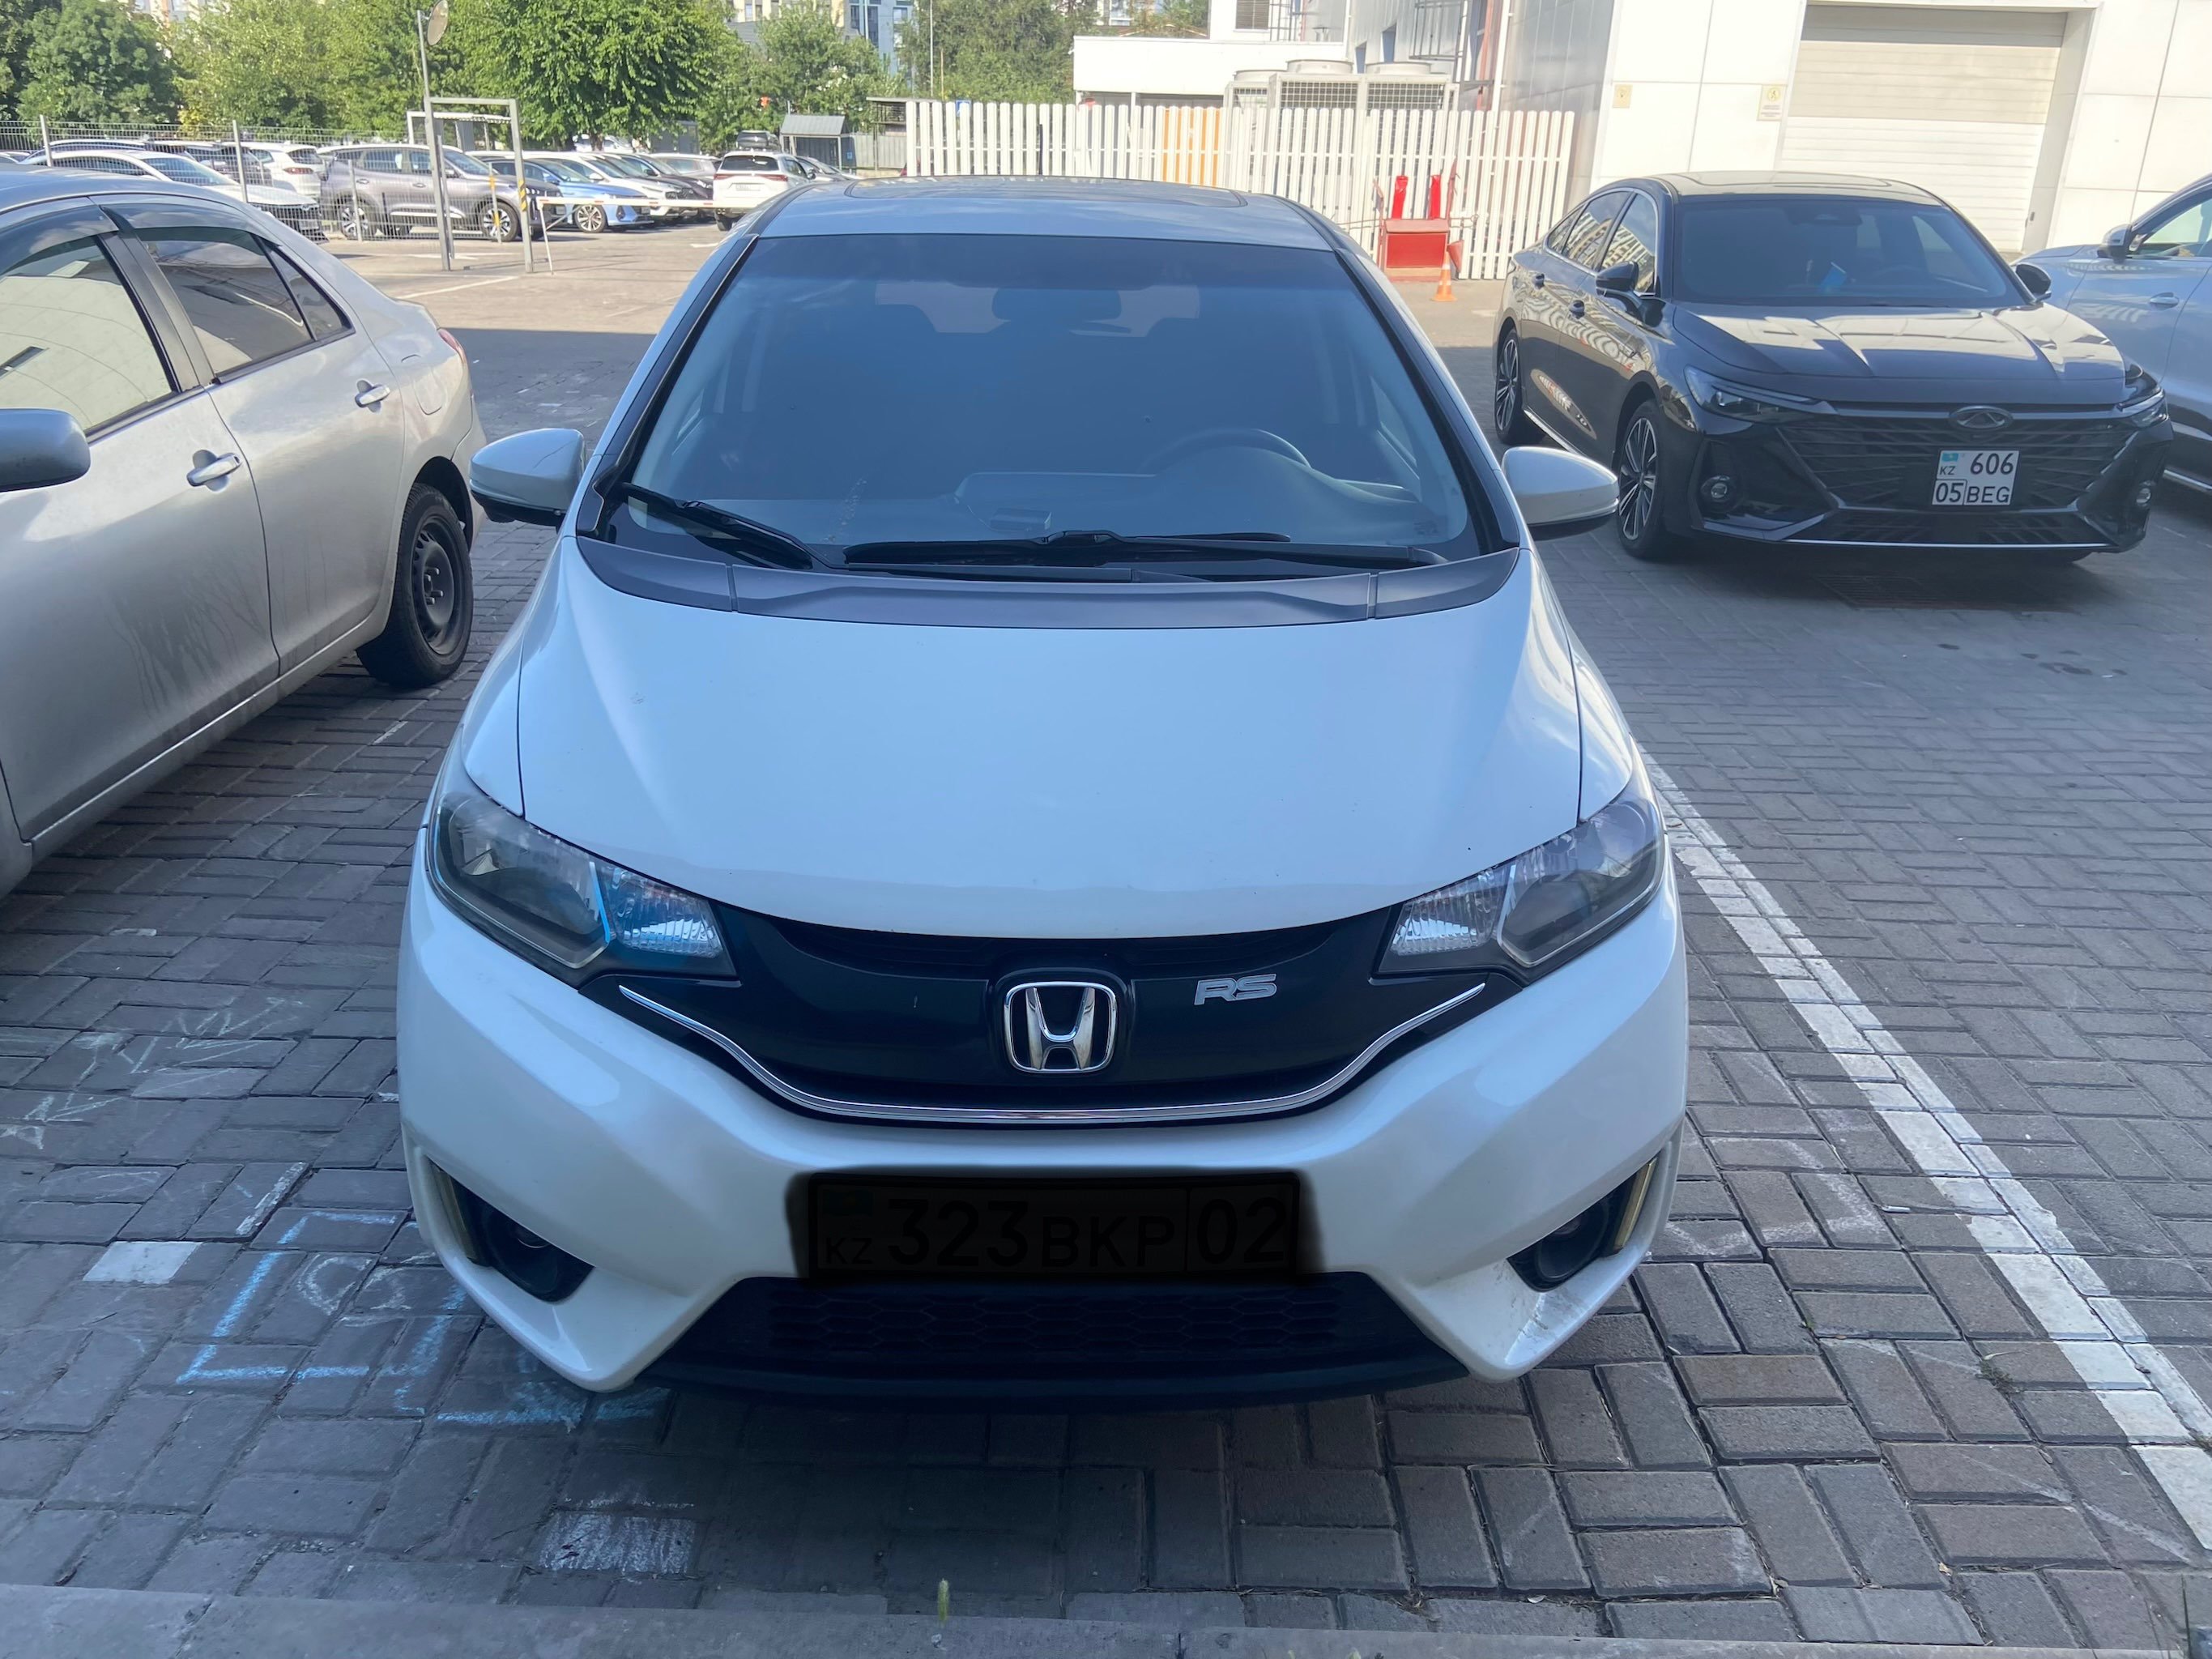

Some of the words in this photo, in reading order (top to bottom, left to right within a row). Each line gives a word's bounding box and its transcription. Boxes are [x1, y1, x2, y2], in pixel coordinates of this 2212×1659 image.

[1939, 466, 1956, 476] KZ
[1970, 453, 2014, 475] 606
[1935, 482, 1964, 503] 05
[1967, 486, 2010, 503] BEG
[1194, 973, 1277, 1005] RS
[825, 1237, 873, 1265] KZ
[1197, 1196, 1287, 1265] 02
